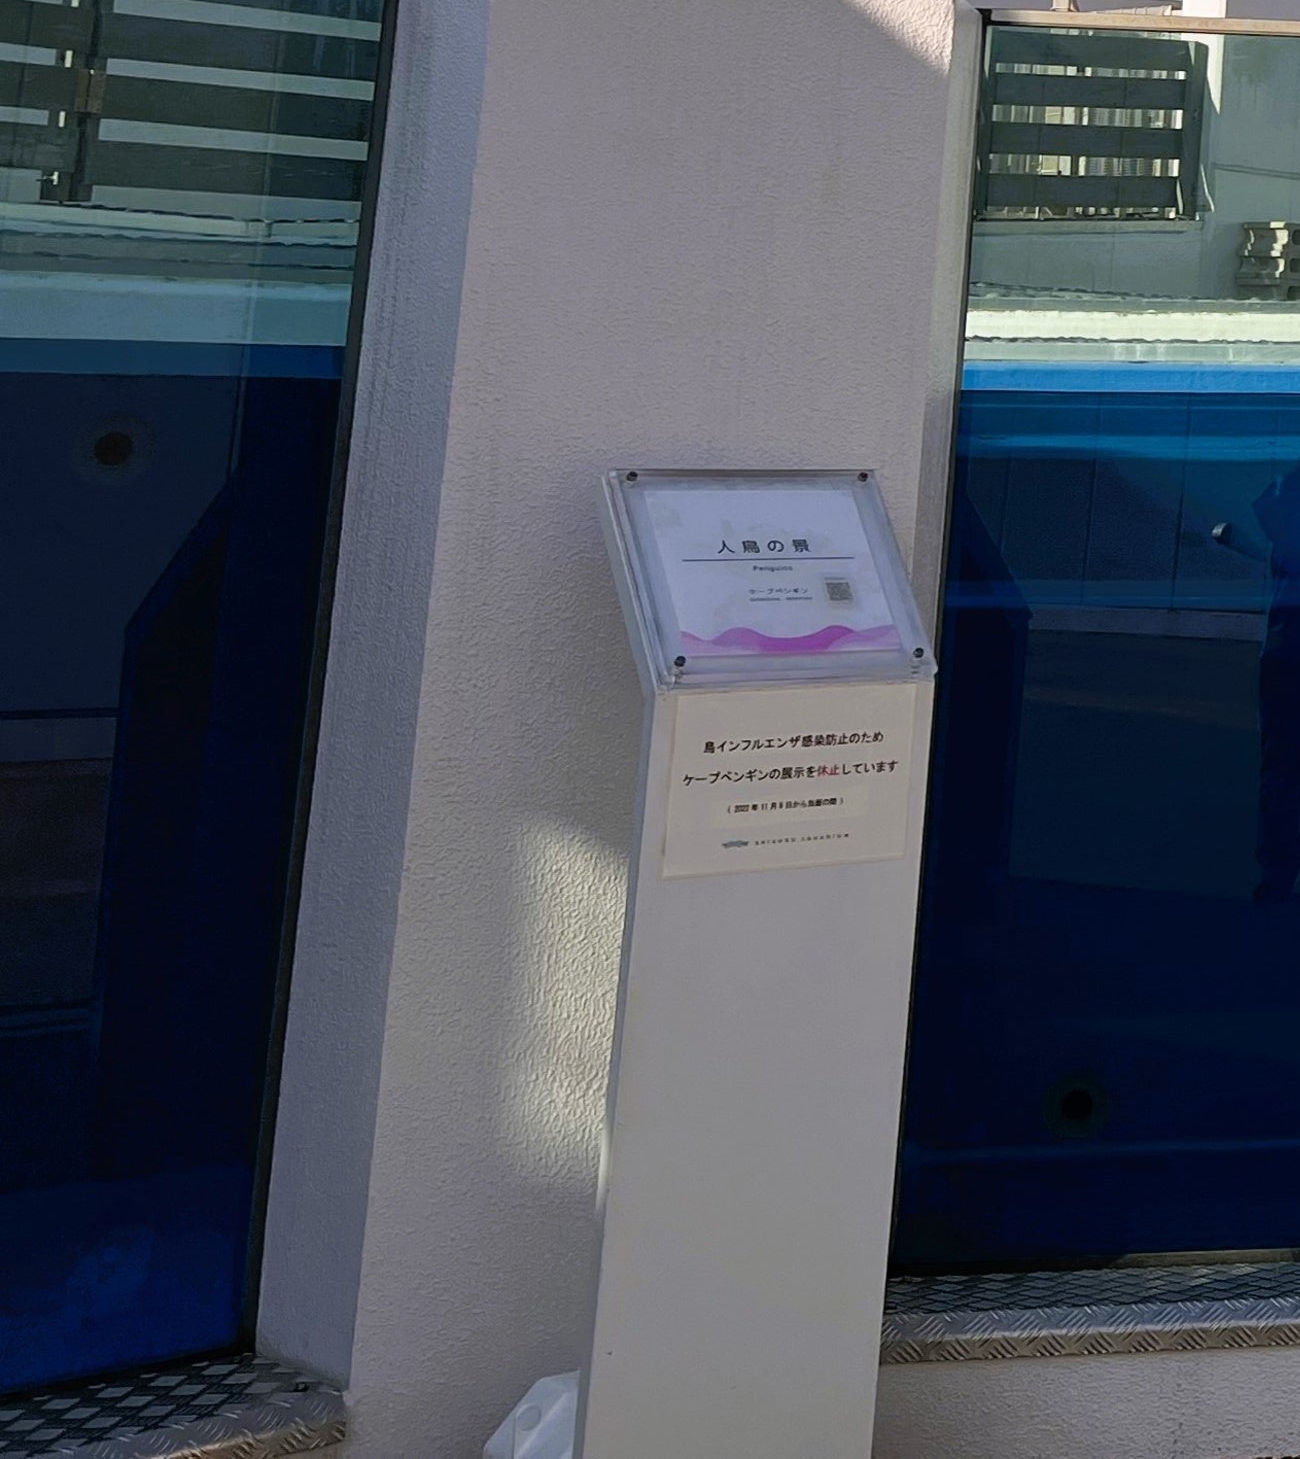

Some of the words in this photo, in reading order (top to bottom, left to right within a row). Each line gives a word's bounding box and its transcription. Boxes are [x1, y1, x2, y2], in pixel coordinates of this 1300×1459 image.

[717, 539, 811, 554] 人鳥の景
[703, 730, 884, 754] 鳥インフルエンザ感染防止のため
[682, 760, 899, 786] ケープペンギンの展示を休止しています
